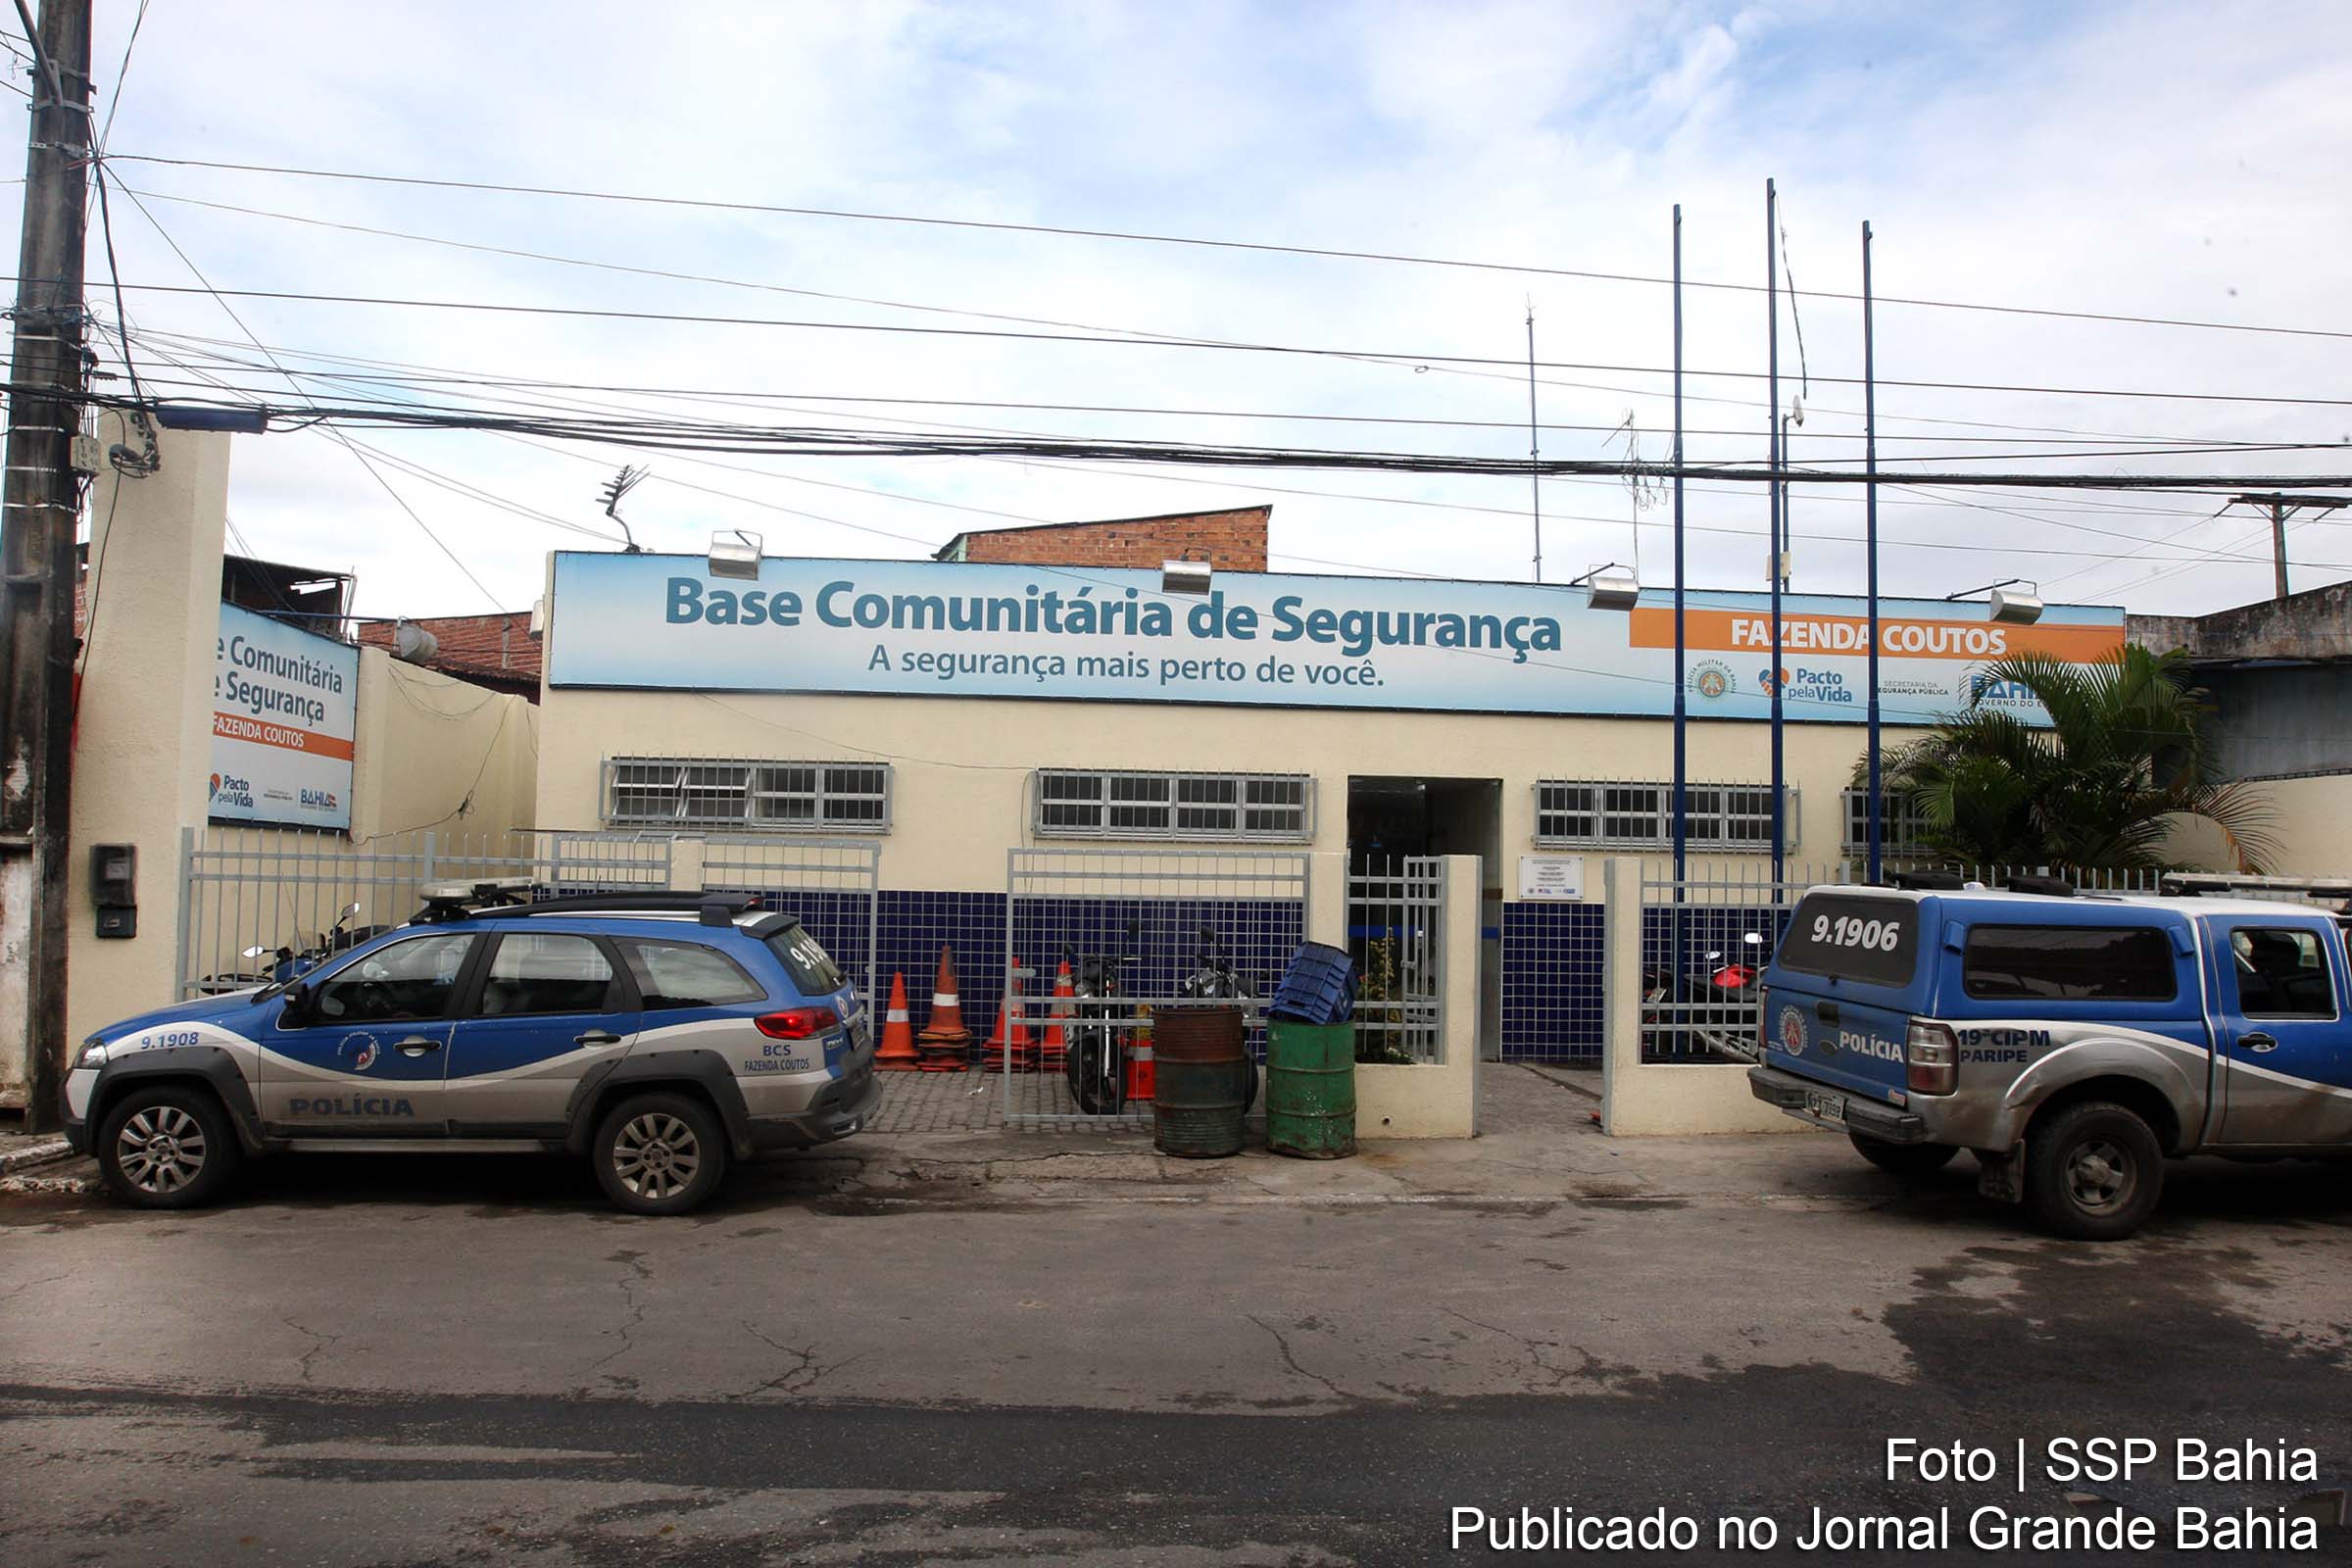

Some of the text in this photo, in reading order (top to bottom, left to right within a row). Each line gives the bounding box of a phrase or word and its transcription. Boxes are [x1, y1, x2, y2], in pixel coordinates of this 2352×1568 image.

[666, 576, 1561, 663] Base Comunitária de Segurança
[1732, 618, 2007, 655] FAZENDA COUTOS
[230, 635, 342, 694] Comunitária
[867, 644, 1384, 686] A segurança mais perto de você.
[1796, 668, 1842, 685] Pacto
[1971, 675, 2035, 699] BAH
[225, 670, 324, 726] Segurança
[1788, 686, 1852, 703] pela Vida
[264, 726, 304, 747] COUTOS
[223, 775, 250, 791] Pacto
[218, 791, 234, 804] pela
[234, 793, 254, 808] Vida
[301, 789, 331, 808] BAHIA
[1811, 914, 1900, 952] 9.1906
[141, 1032, 199, 1050] 9.1908
[762, 1045, 792, 1056] BCS
[1839, 1030, 1904, 1063] POLÍCIA
[745, 1058, 809, 1071] FAZENDA COUTOS
[1960, 1051, 2028, 1062] PARIPE
[290, 1094, 415, 1116] POLÍCIA
